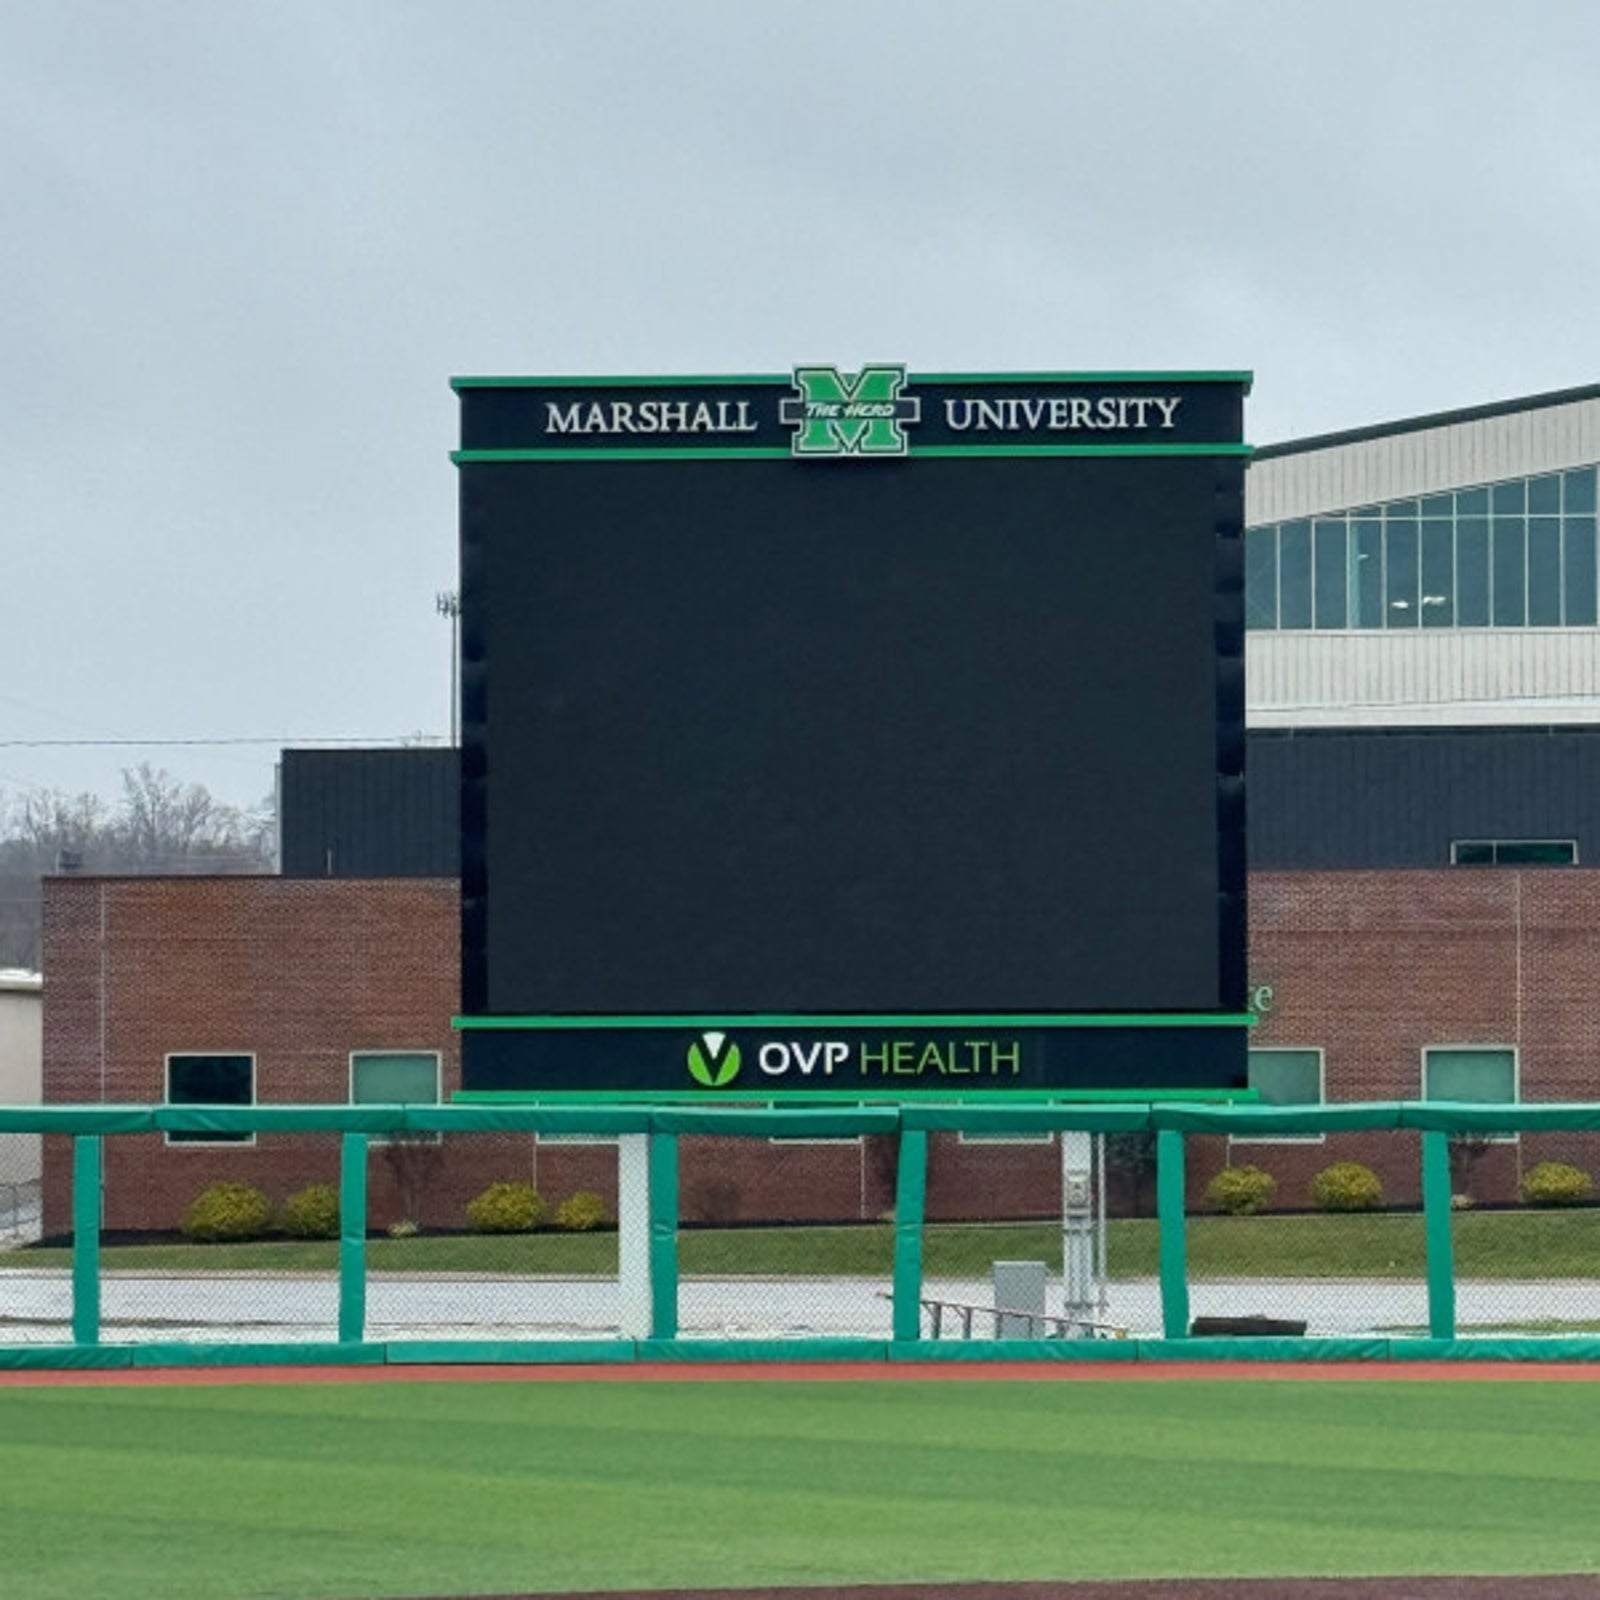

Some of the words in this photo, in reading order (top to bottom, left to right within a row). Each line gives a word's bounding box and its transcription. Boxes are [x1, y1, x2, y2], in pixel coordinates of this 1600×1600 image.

[545, 401, 758, 433] MARSHALL
[944, 397, 1181, 430] UNIVERSITY
[806, 402, 841, 417] THE
[842, 402, 895, 417] HERD
[758, 1041, 850, 1075] OVP
[859, 1041, 1020, 1075] HEALTH
